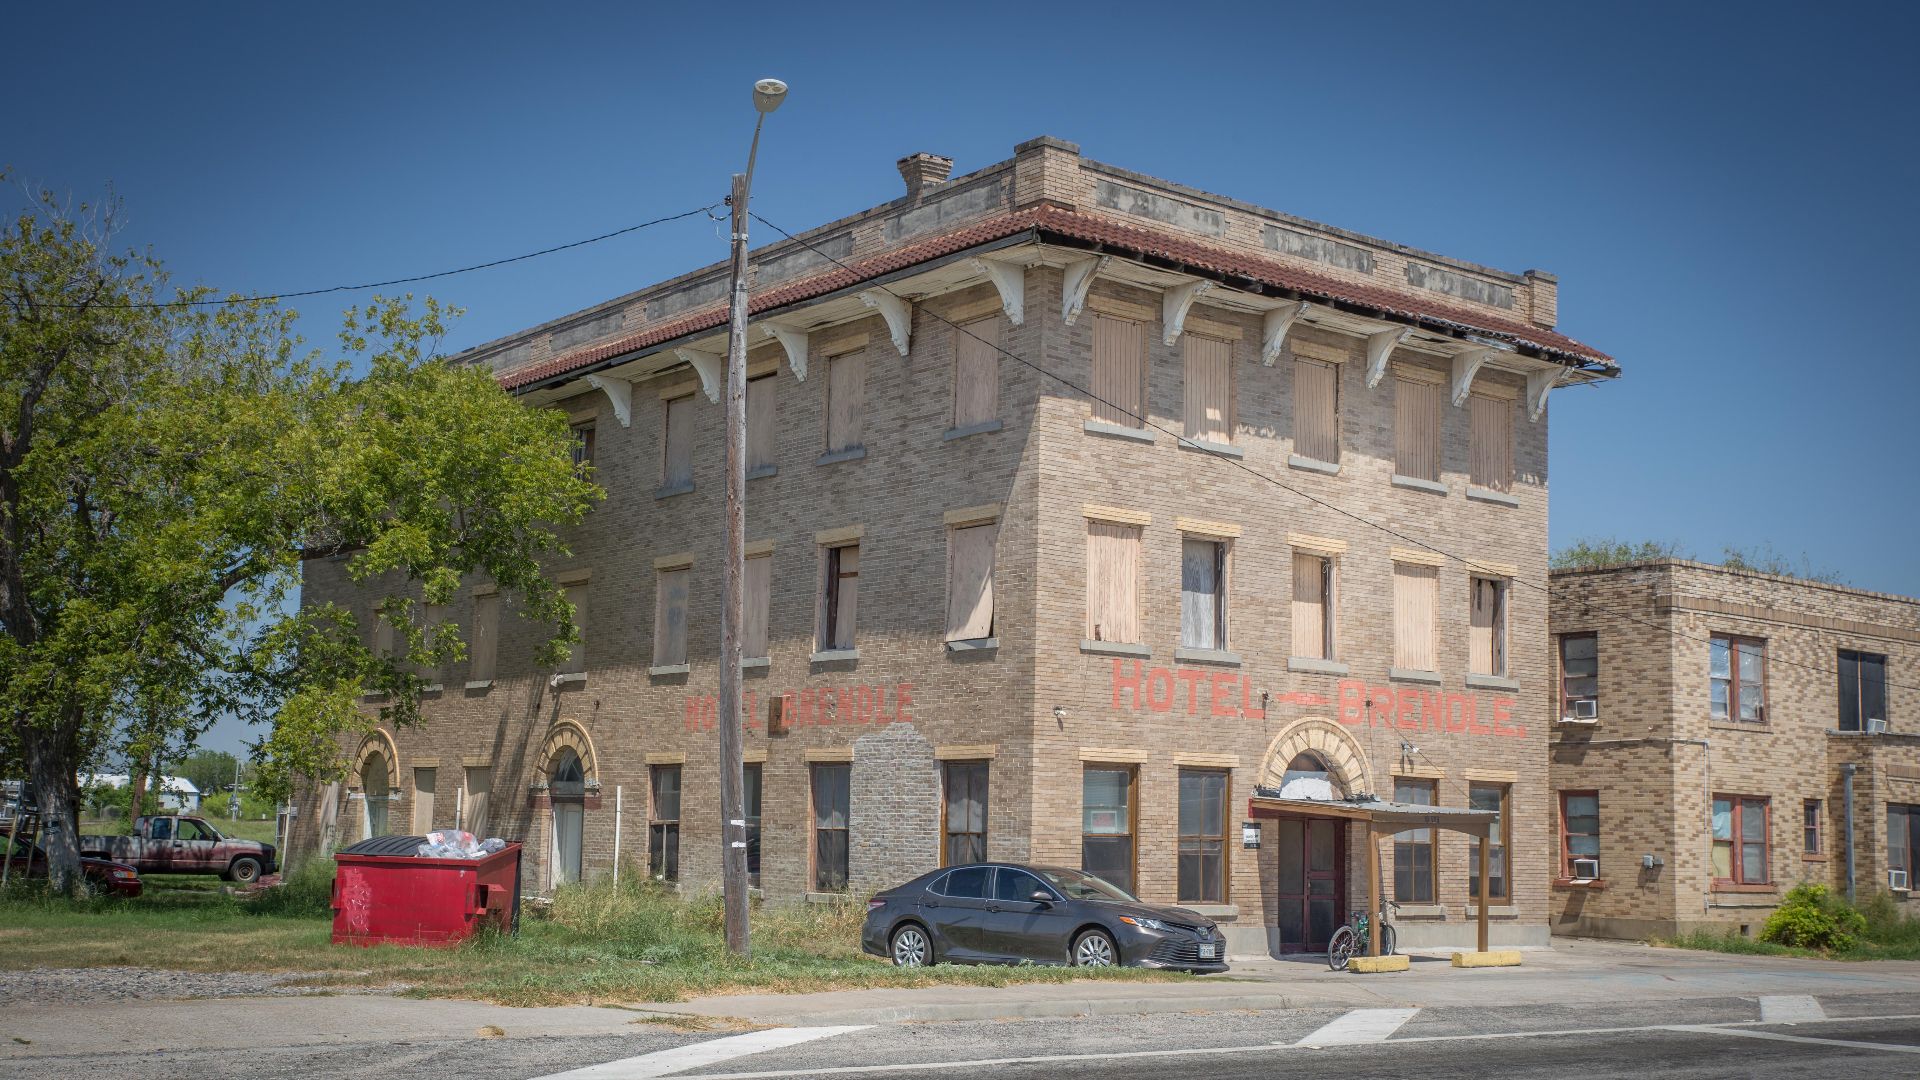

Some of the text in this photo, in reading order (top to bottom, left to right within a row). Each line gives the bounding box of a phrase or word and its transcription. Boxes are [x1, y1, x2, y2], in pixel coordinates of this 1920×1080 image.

[684, 682, 914, 732] HOL BRENDLE
[1111, 658, 1266, 719] HOTEL
